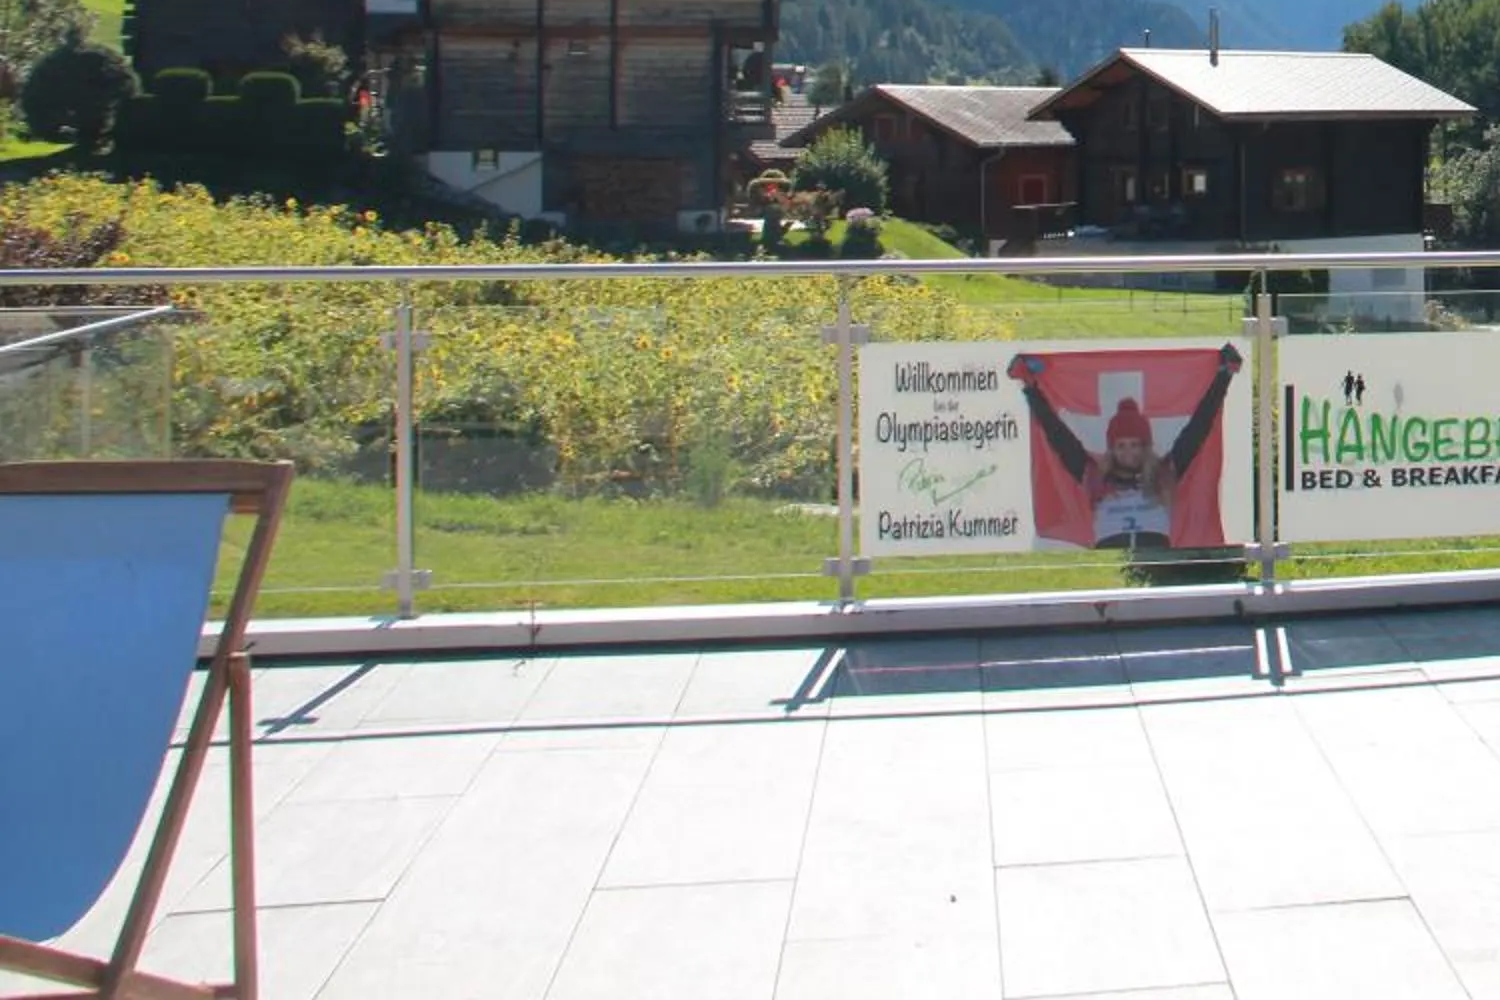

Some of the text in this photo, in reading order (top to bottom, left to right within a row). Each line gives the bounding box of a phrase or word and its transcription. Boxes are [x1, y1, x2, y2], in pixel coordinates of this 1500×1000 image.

[895, 362, 998, 393] Willkommen
[876, 412, 1018, 451] Olympiasiegerin
[1301, 468, 1354, 490] BED
[1363, 469, 1382, 487] &
[879, 509, 1019, 540] Patrizia Kummer
